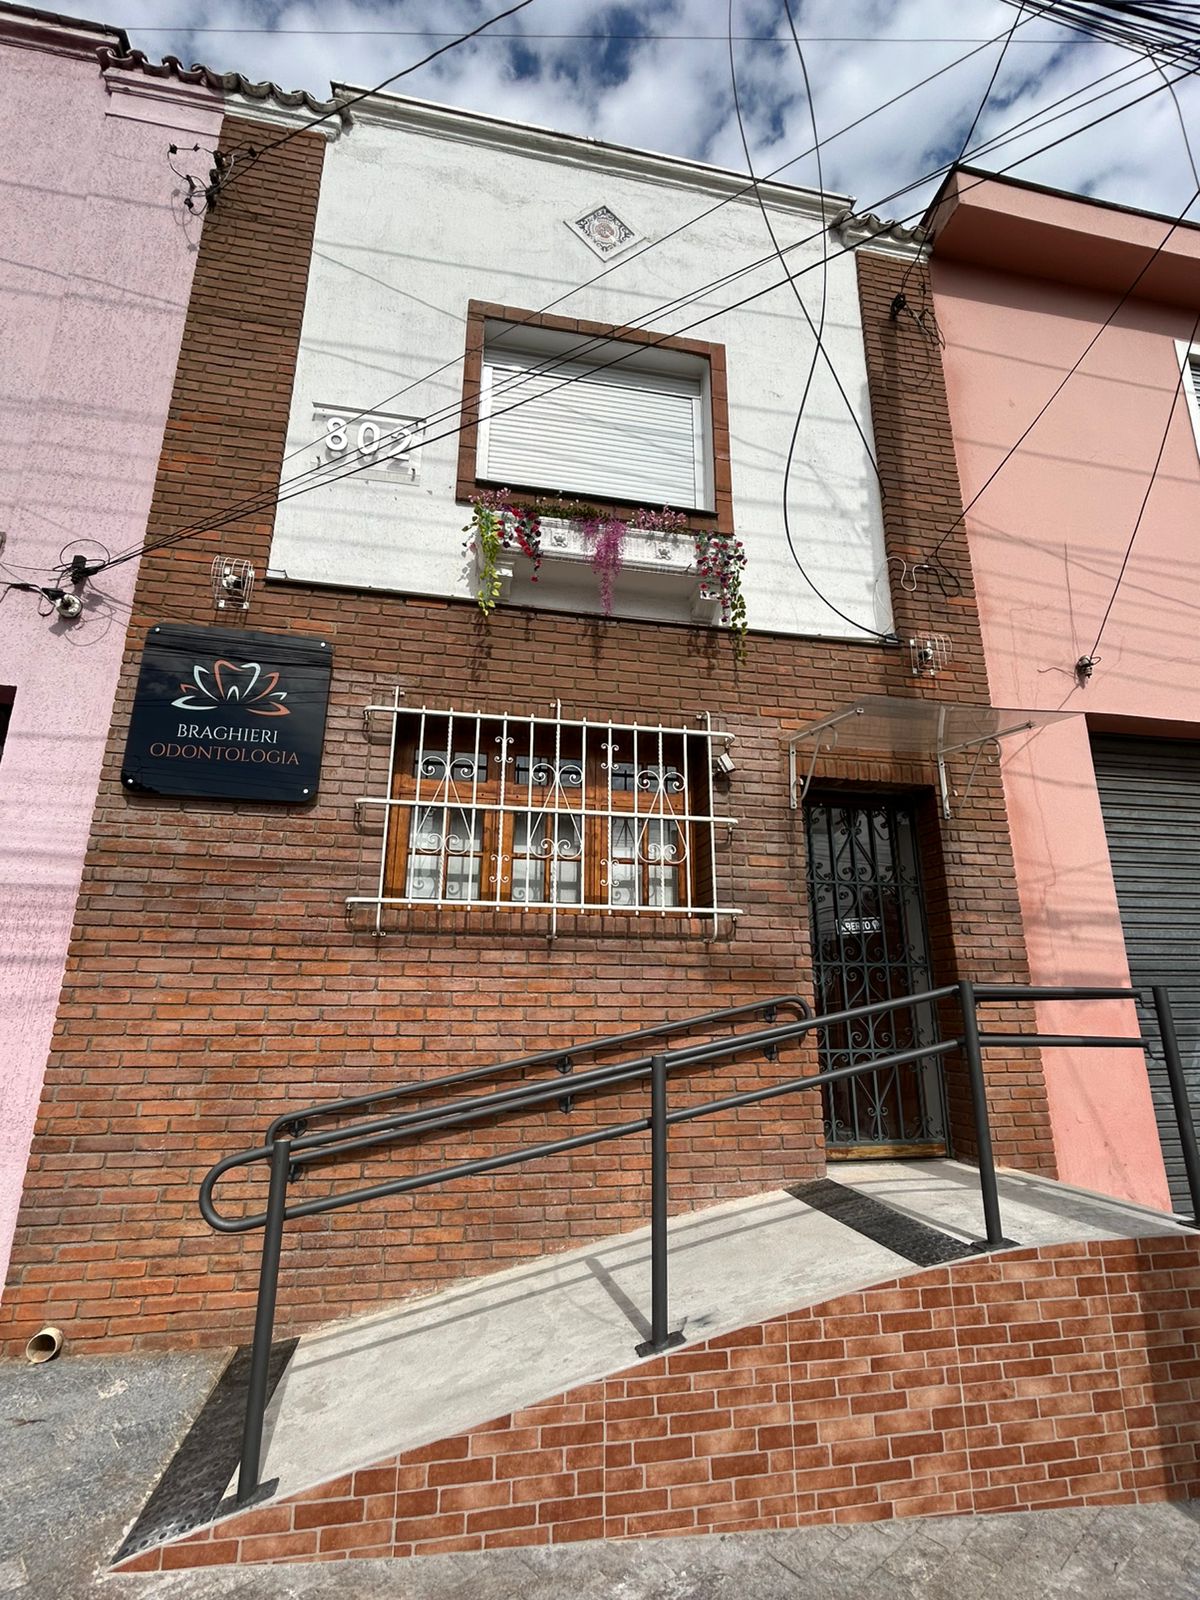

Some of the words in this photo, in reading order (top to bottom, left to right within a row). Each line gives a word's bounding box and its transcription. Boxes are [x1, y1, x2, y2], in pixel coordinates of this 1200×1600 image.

[325, 417, 412, 461] 802
[177, 723, 278, 744] BRAGHIERI
[150, 742, 299, 765] ODONTOLOGIA
